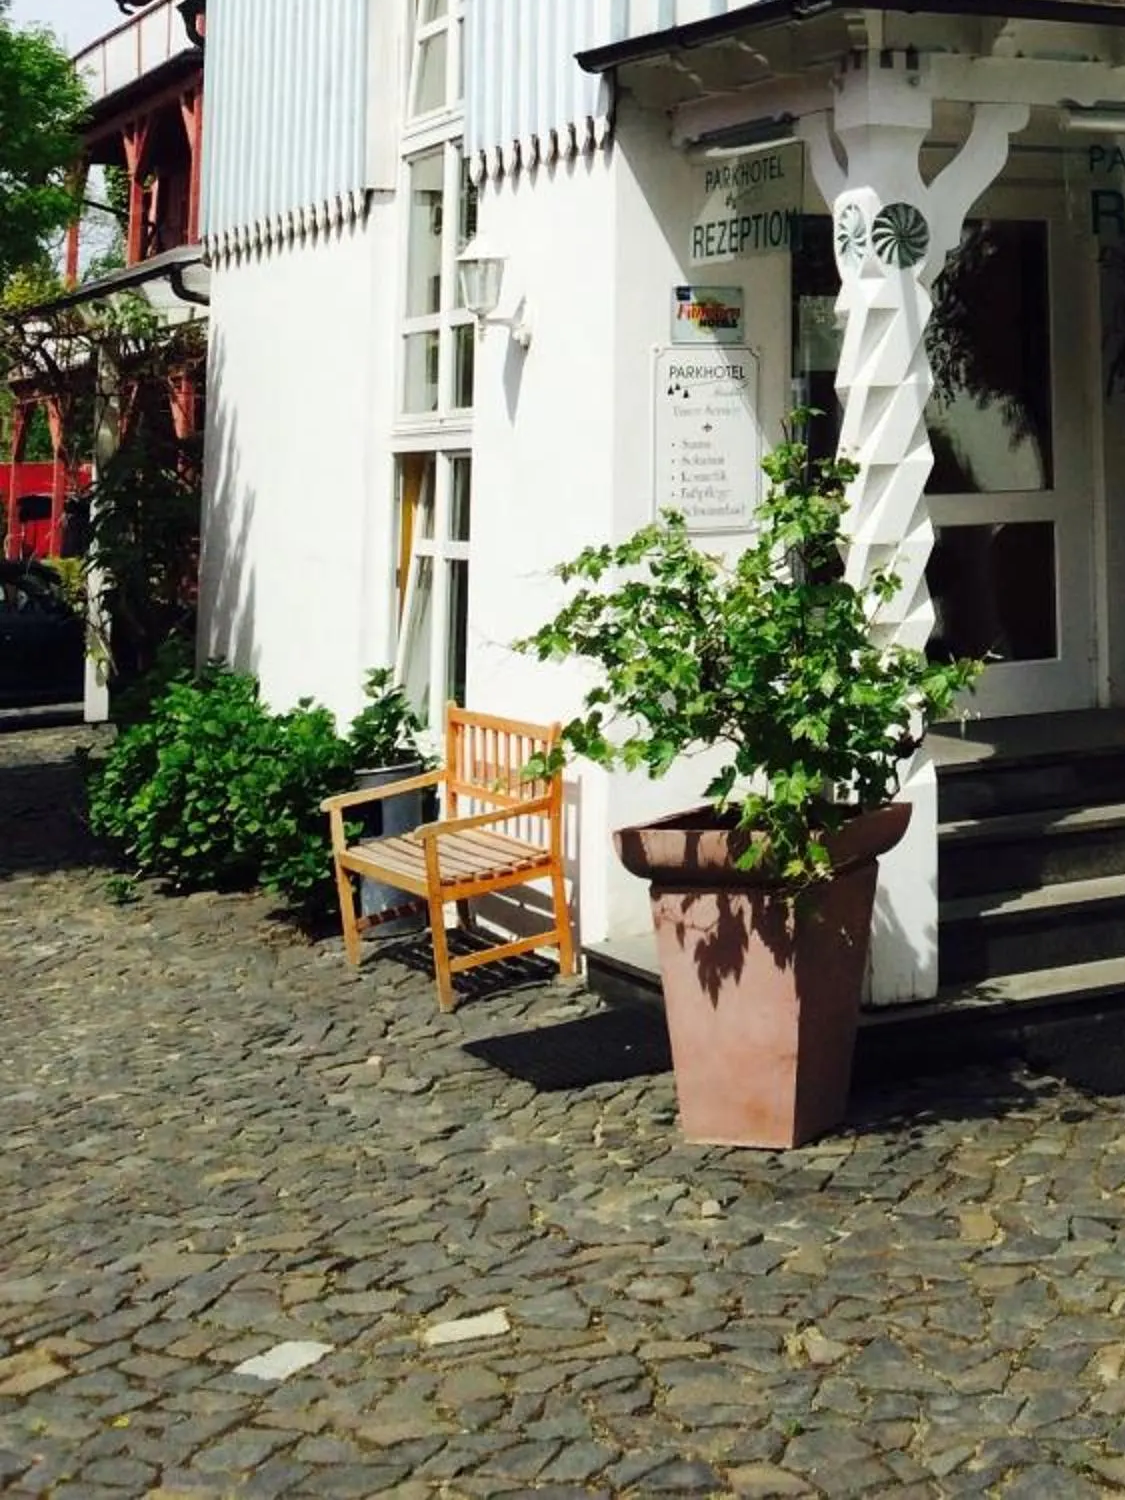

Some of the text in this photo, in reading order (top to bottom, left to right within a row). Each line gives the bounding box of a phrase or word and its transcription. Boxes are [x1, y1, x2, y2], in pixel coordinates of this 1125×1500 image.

[705, 155, 784, 193] PARKHOTEL
[693, 205, 798, 259] REZEPTION
[669, 365, 746, 380] PARKHOTEL
